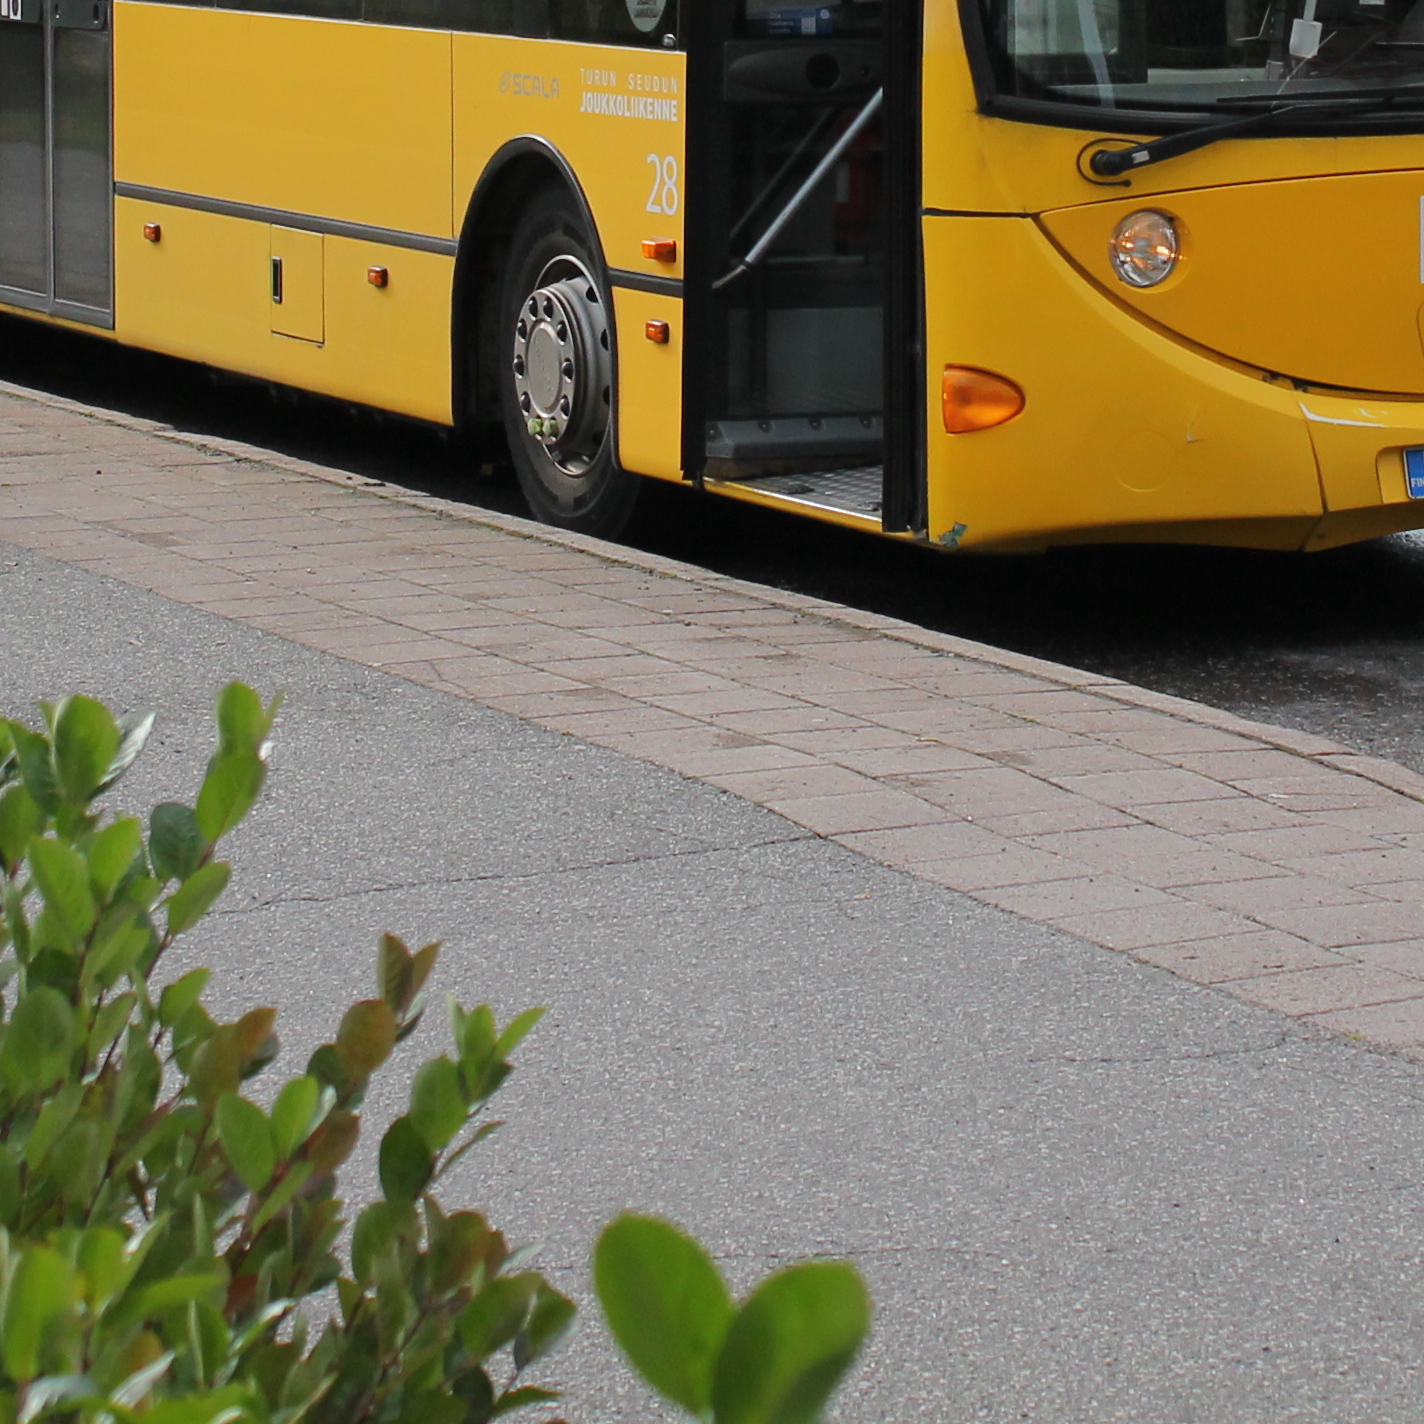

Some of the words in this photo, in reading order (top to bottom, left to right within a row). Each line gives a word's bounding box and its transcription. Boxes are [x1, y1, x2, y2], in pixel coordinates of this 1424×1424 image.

[512, 73, 561, 98] SCALA
[580, 68, 617, 86] TURUN
[628, 73, 678, 93] SEUDUN
[580, 91, 678, 122] JOUKKOLIIKENNE
[646, 153, 679, 216] 28
